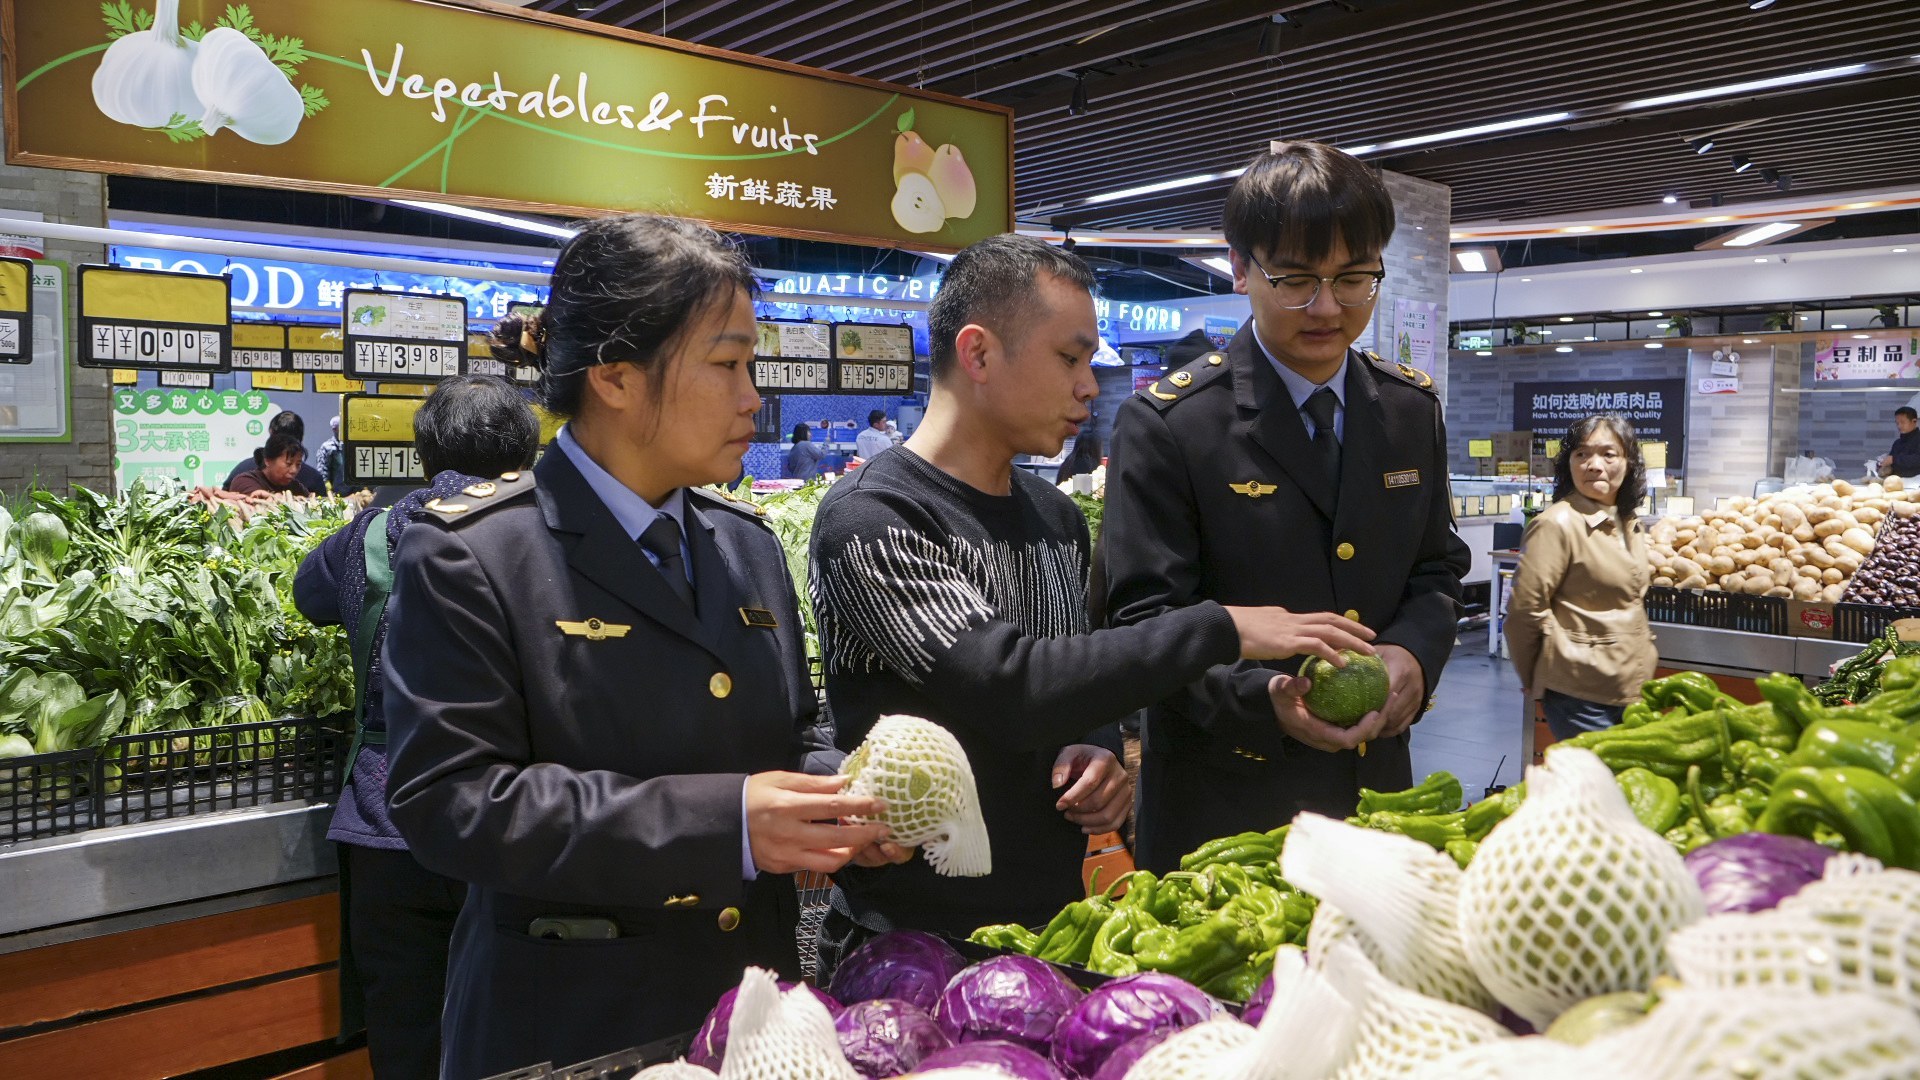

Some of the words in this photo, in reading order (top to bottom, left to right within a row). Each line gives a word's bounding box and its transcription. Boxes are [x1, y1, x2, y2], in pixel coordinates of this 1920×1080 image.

[690, 94, 819, 155] Fruits
[704, 172, 838, 211] 新鲜蔬果
[1832, 345, 1903, 363] 豆制品
[119, 394, 263, 410] 又多放心豆芽
[1532, 392, 1663, 410] 如何选购优质肉品
[1532, 411, 1549, 419] How
[1549, 411, 1558, 419] To
[1559, 411, 1585, 419] Choose
[1633, 410, 1662, 420] Quality
